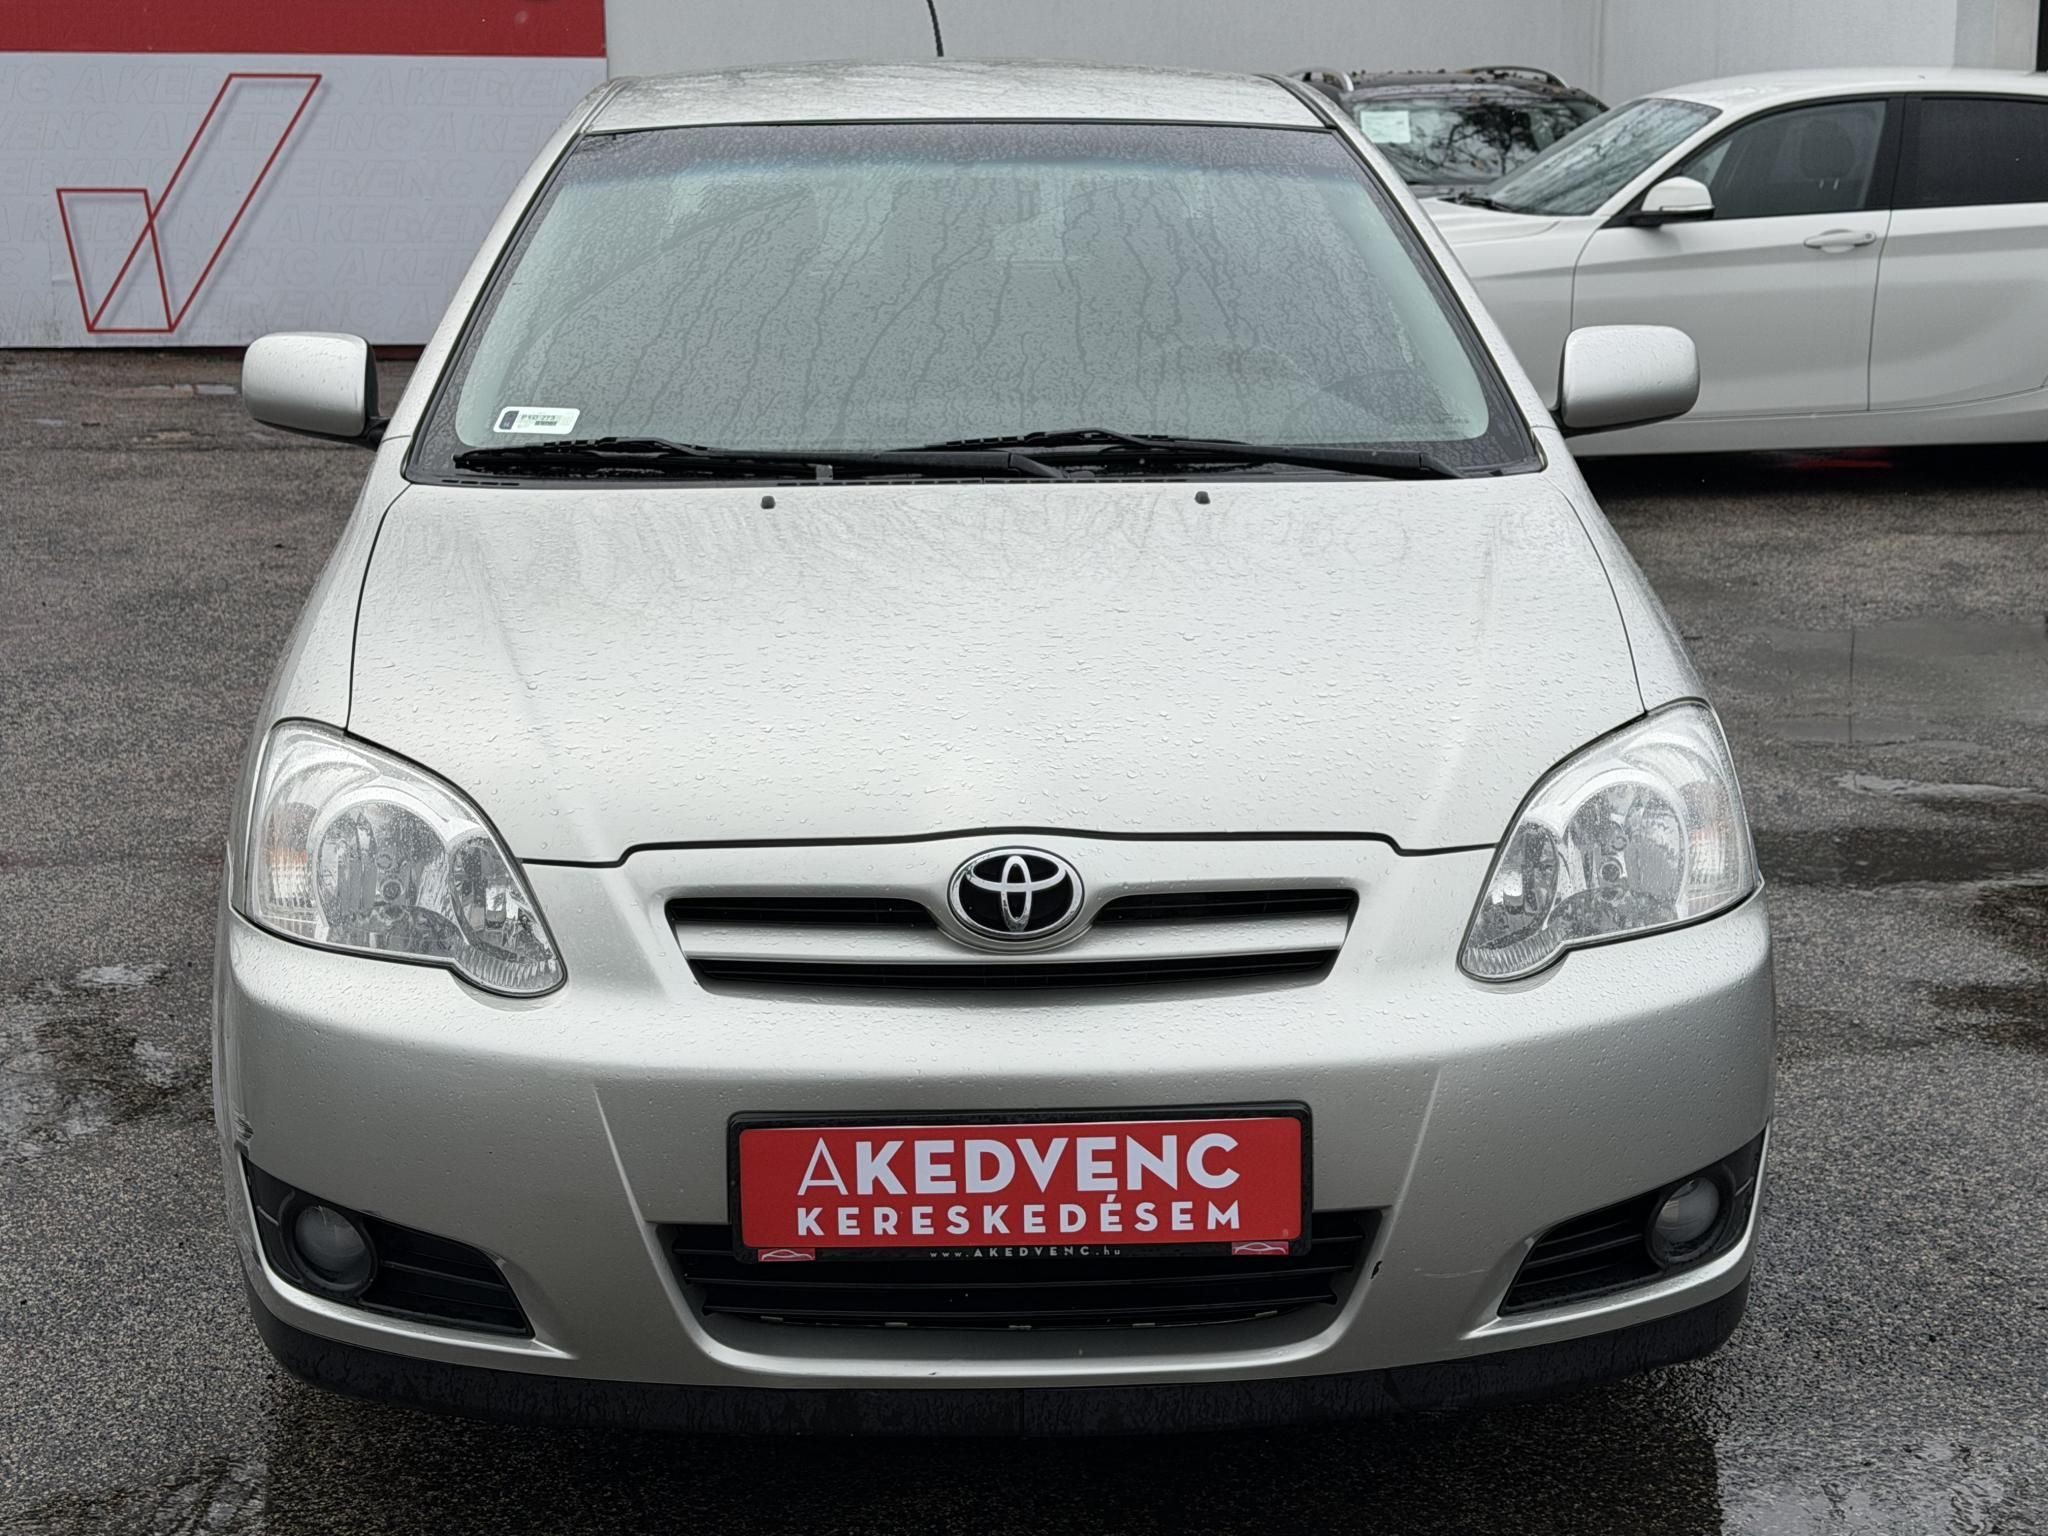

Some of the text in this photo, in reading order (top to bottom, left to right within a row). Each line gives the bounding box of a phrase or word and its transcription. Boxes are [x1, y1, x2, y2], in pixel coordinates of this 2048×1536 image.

[797, 1132, 1241, 1196] AKEDVENC
[797, 1195, 1241, 1237] KERESKEDÉSEM
[929, 1246, 1122, 1258] www.AKEDVENC.hu
